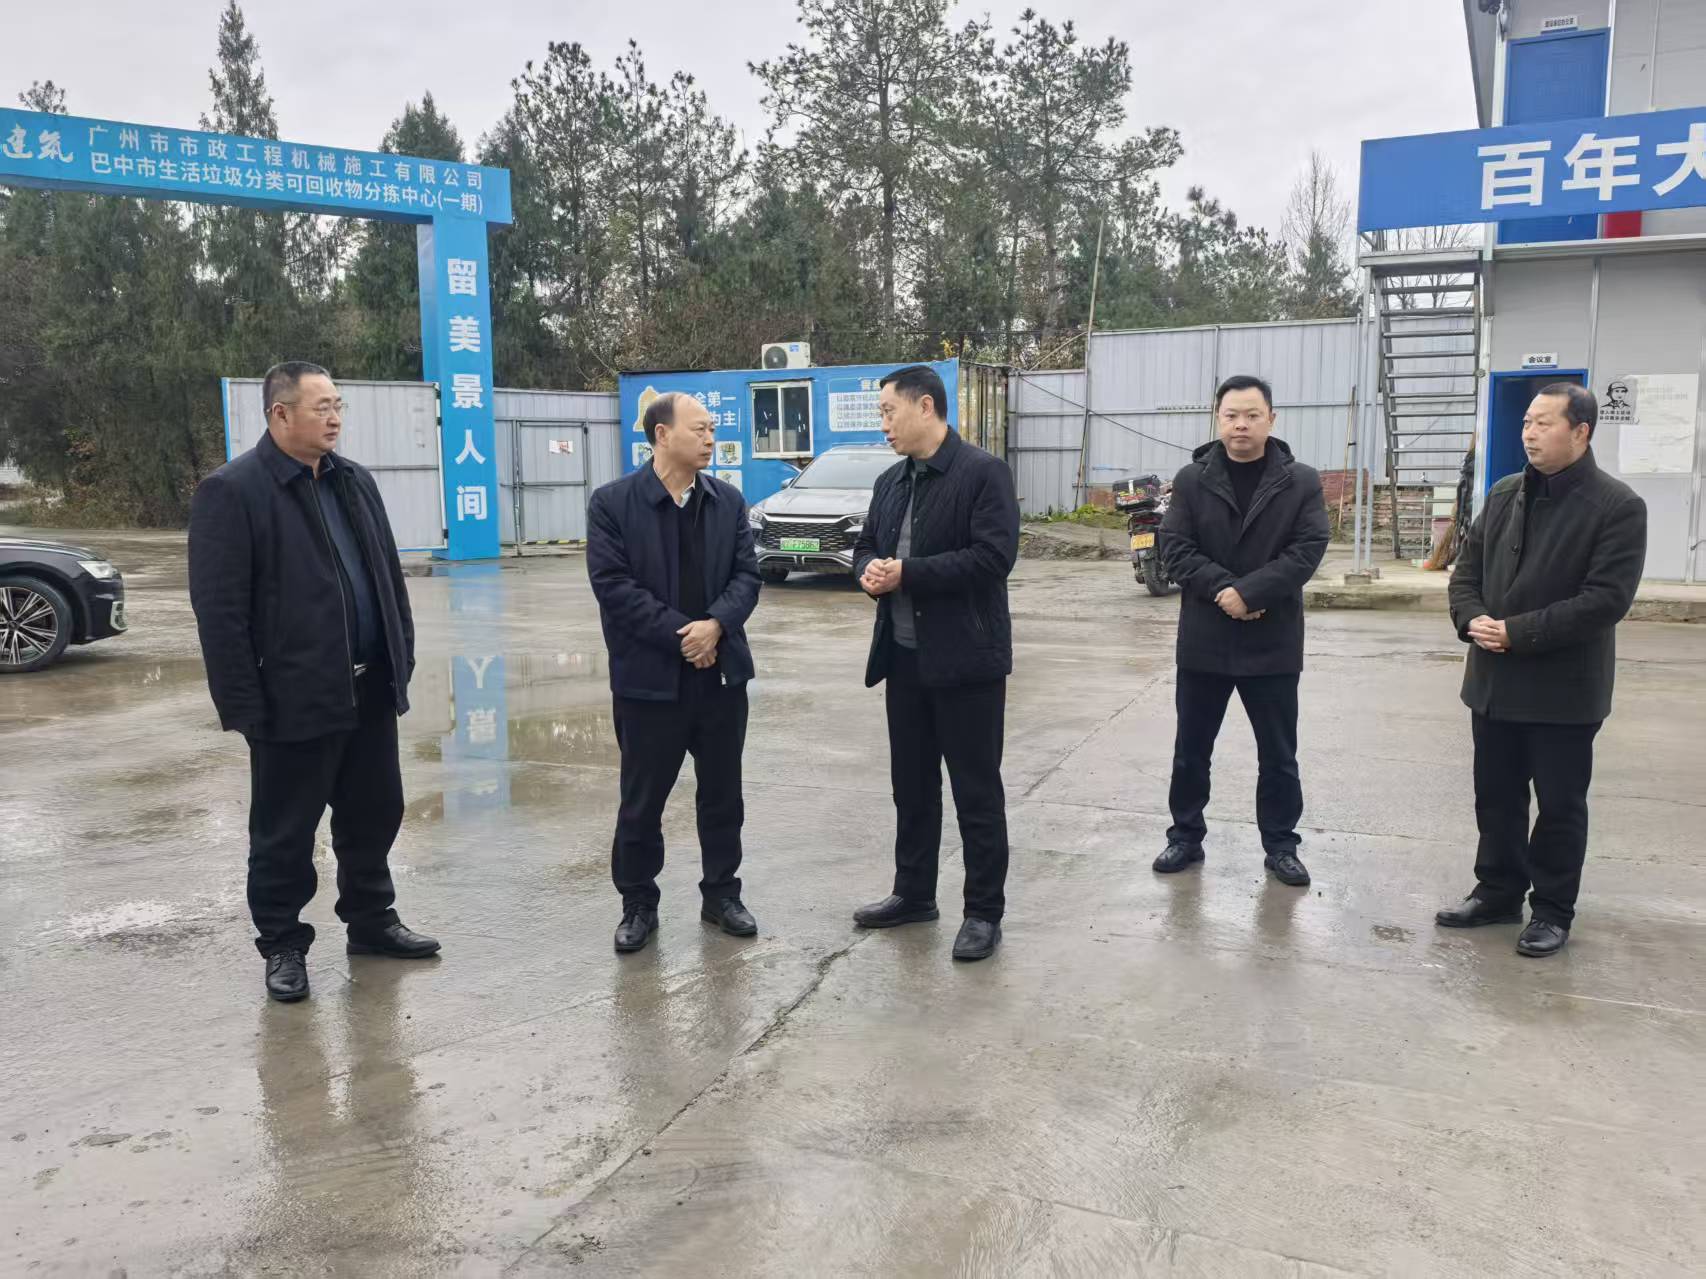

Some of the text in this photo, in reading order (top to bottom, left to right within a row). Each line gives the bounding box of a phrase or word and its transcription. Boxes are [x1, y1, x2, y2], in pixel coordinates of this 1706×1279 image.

[89, 125, 483, 190] 广州市市政工程机械施工有限公司
[90, 151, 483, 215] 巴中市生活垃圾分类可回收物分拣中心(一期)
[1477, 123, 1706, 210] 百年大
[447, 258, 488, 521] 留美景人间
[689, 391, 737, 407] 全第一
